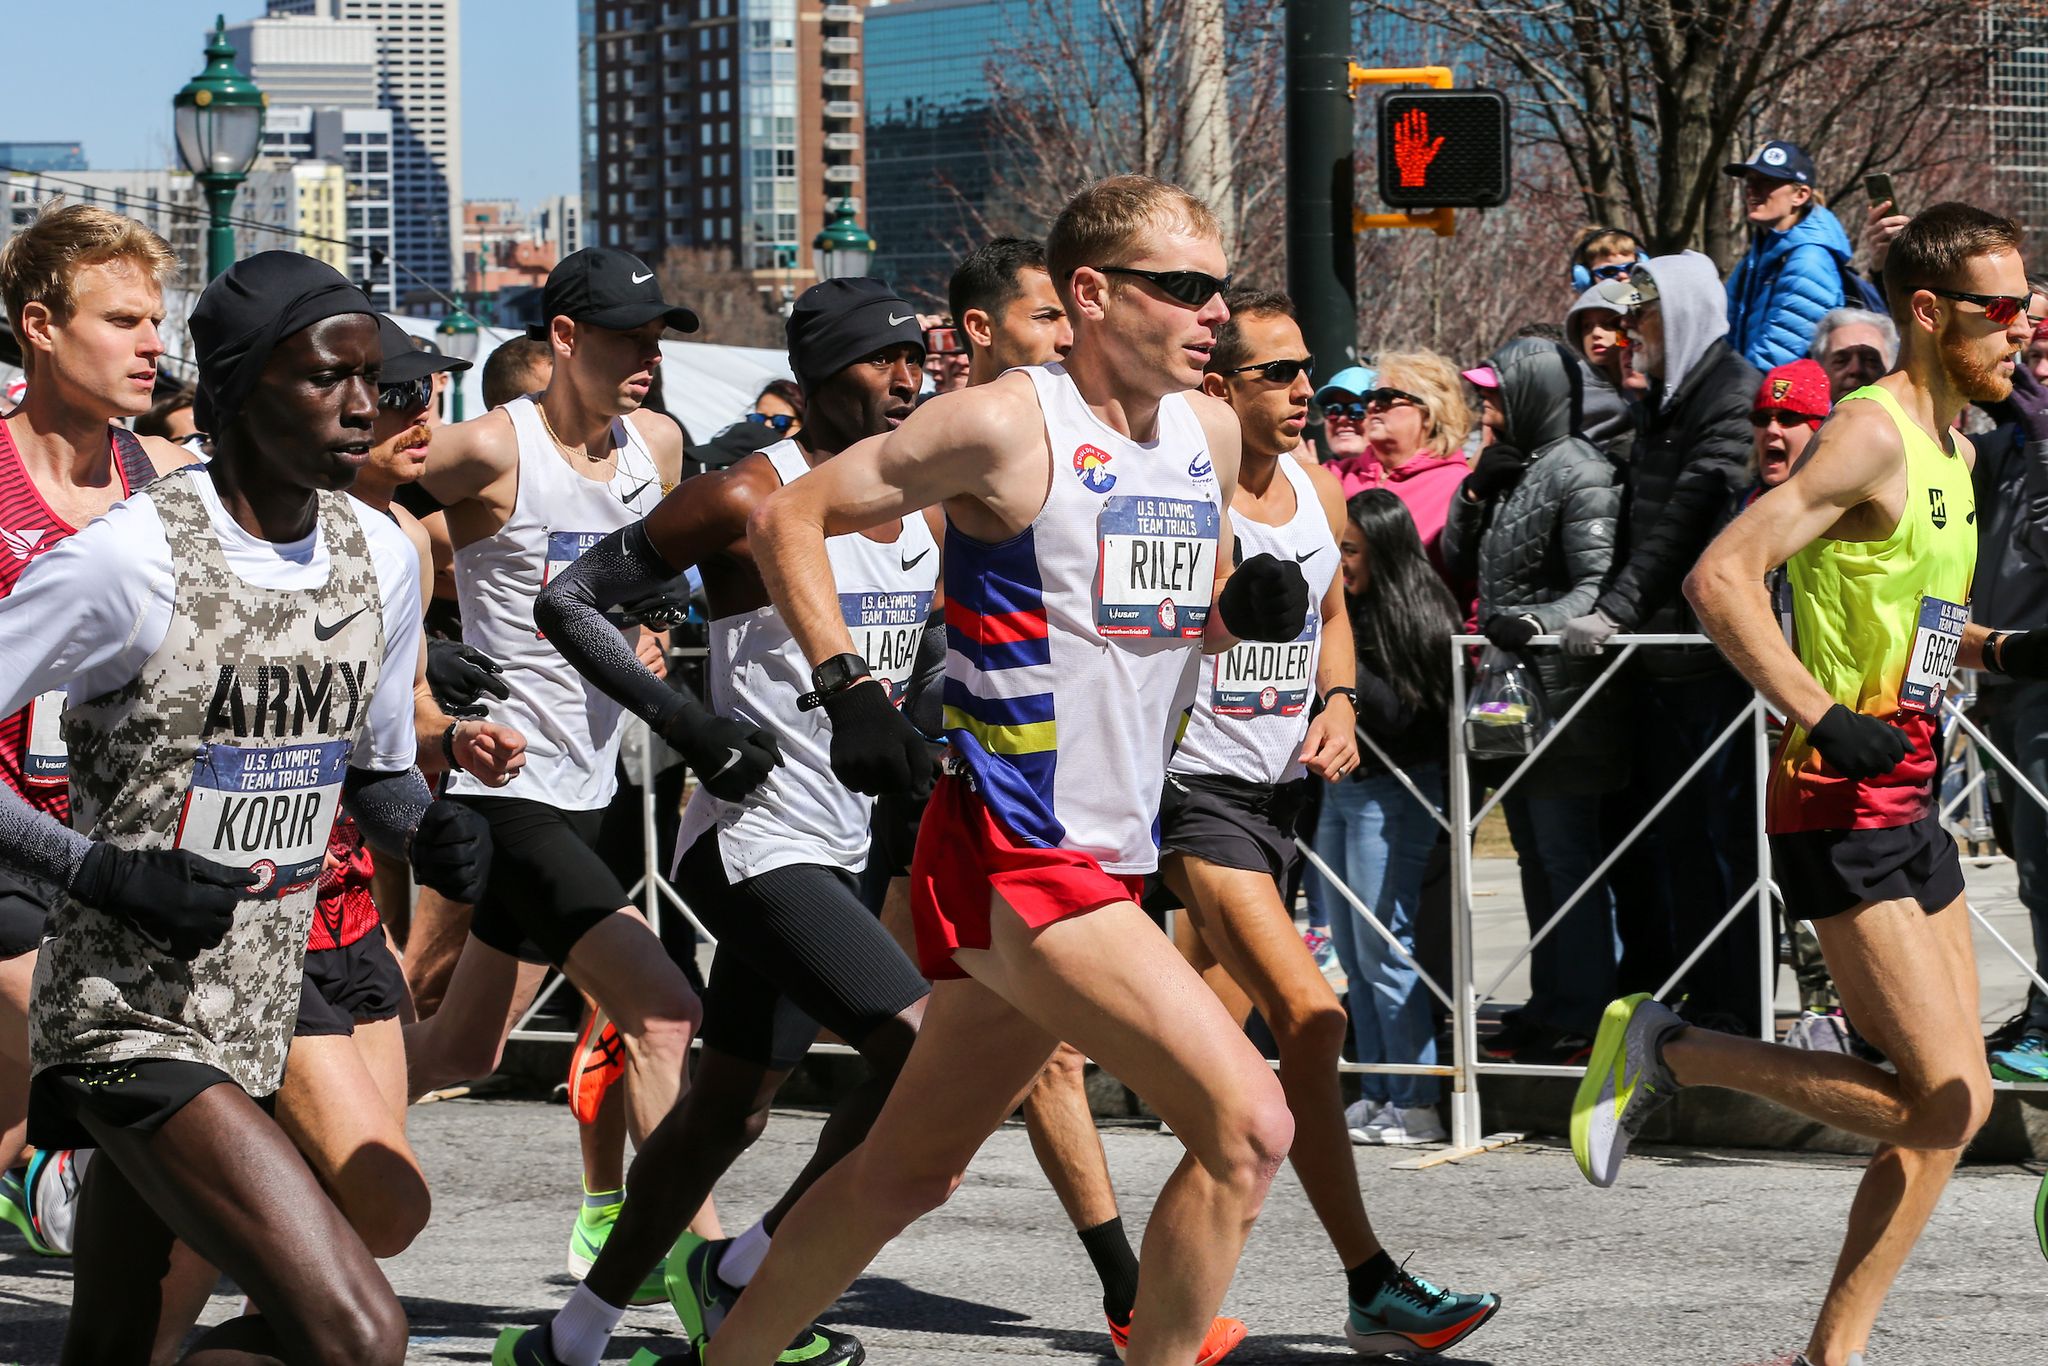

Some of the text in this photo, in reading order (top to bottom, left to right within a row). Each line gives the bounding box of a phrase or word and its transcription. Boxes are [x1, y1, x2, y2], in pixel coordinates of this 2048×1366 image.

[1137, 501, 1157, 516] U.S.
[1138, 519, 1198, 536] TEAM TRIALS
[1207, 516, 1212, 526] 5
[579, 535, 595, 547] U.S
[1130, 539, 1202, 591] RILEY
[862, 596, 876, 609] U.S.
[877, 595, 917, 609] OLYMPIC
[861, 609, 916, 625] TEAM TRIALS
[1118, 611, 1140, 619] USATF
[866, 626, 923, 670] LAGA
[1225, 645, 1309, 681] NADLER
[202, 661, 367, 738] ARMY
[244, 749, 321, 771] U.S. OLYMPIC
[333, 759, 340, 771] 3
[241, 768, 319, 790] TEAM TRIALS
[212, 792, 321, 852] KORIR
